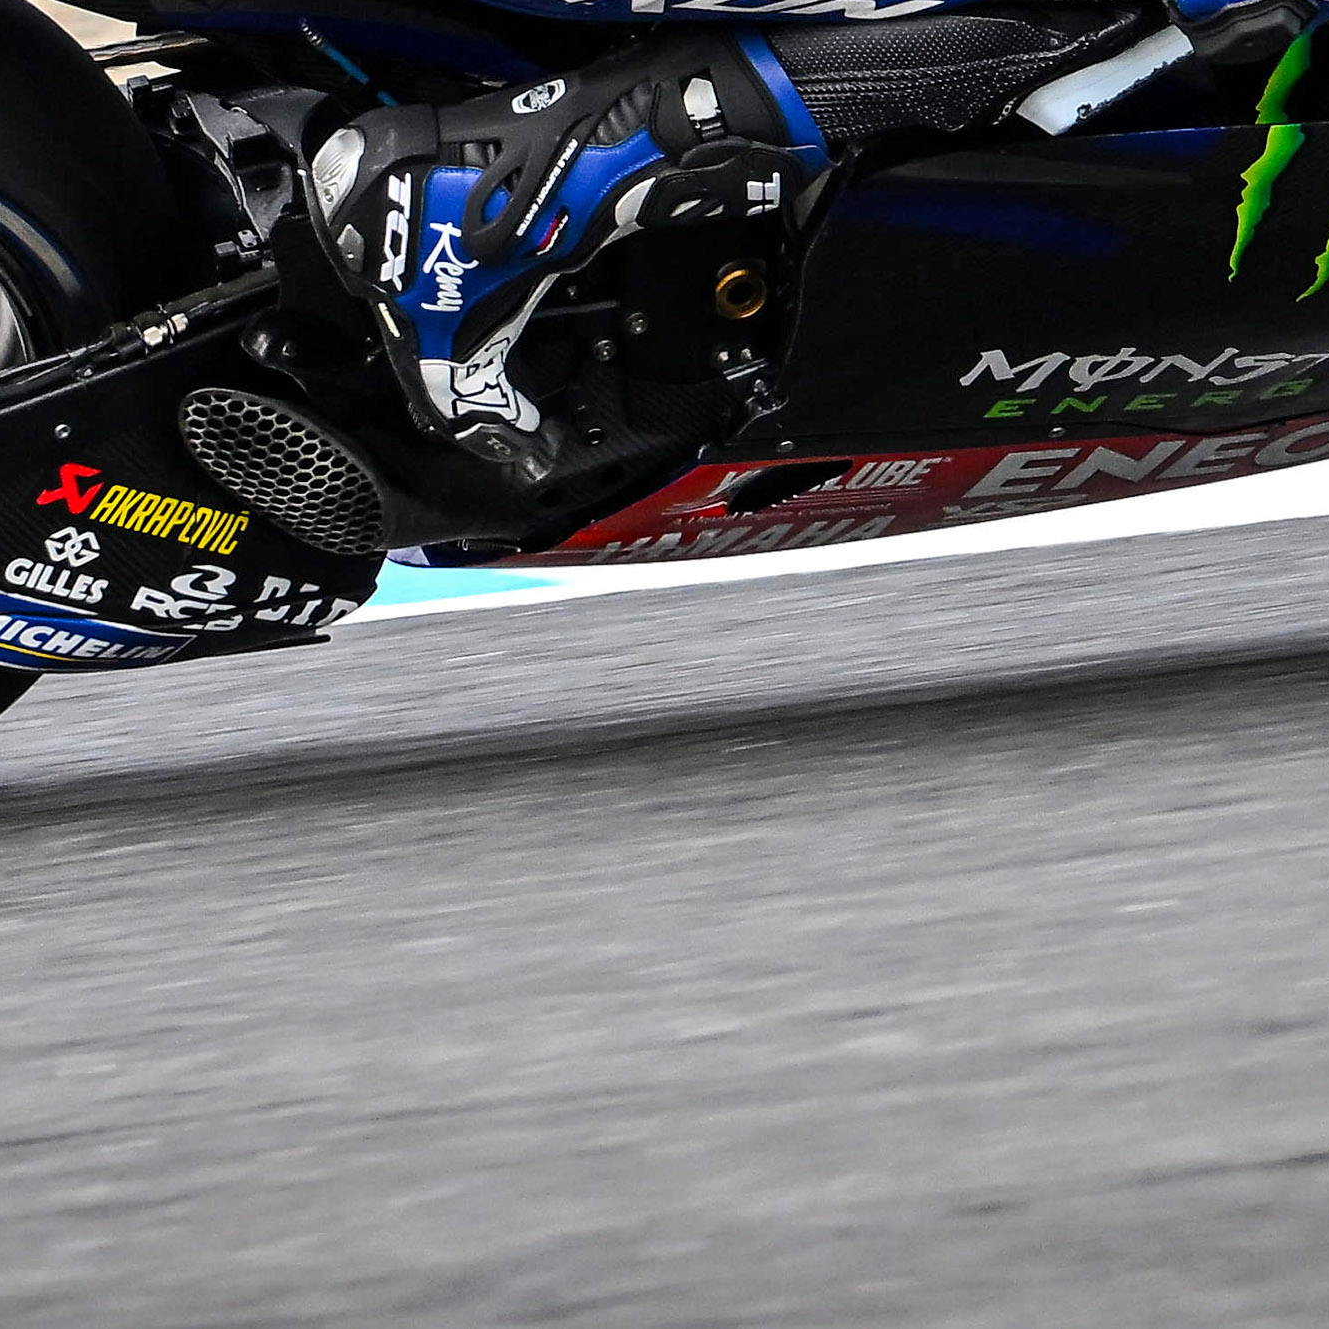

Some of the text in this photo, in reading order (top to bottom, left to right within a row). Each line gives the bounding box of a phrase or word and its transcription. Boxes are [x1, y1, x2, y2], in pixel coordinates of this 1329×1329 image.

[380, 172, 412, 292] TCX
[420, 222, 480, 312] Remy
[4, 556, 110, 604] GILLES
[130, 585, 243, 632] RCB
